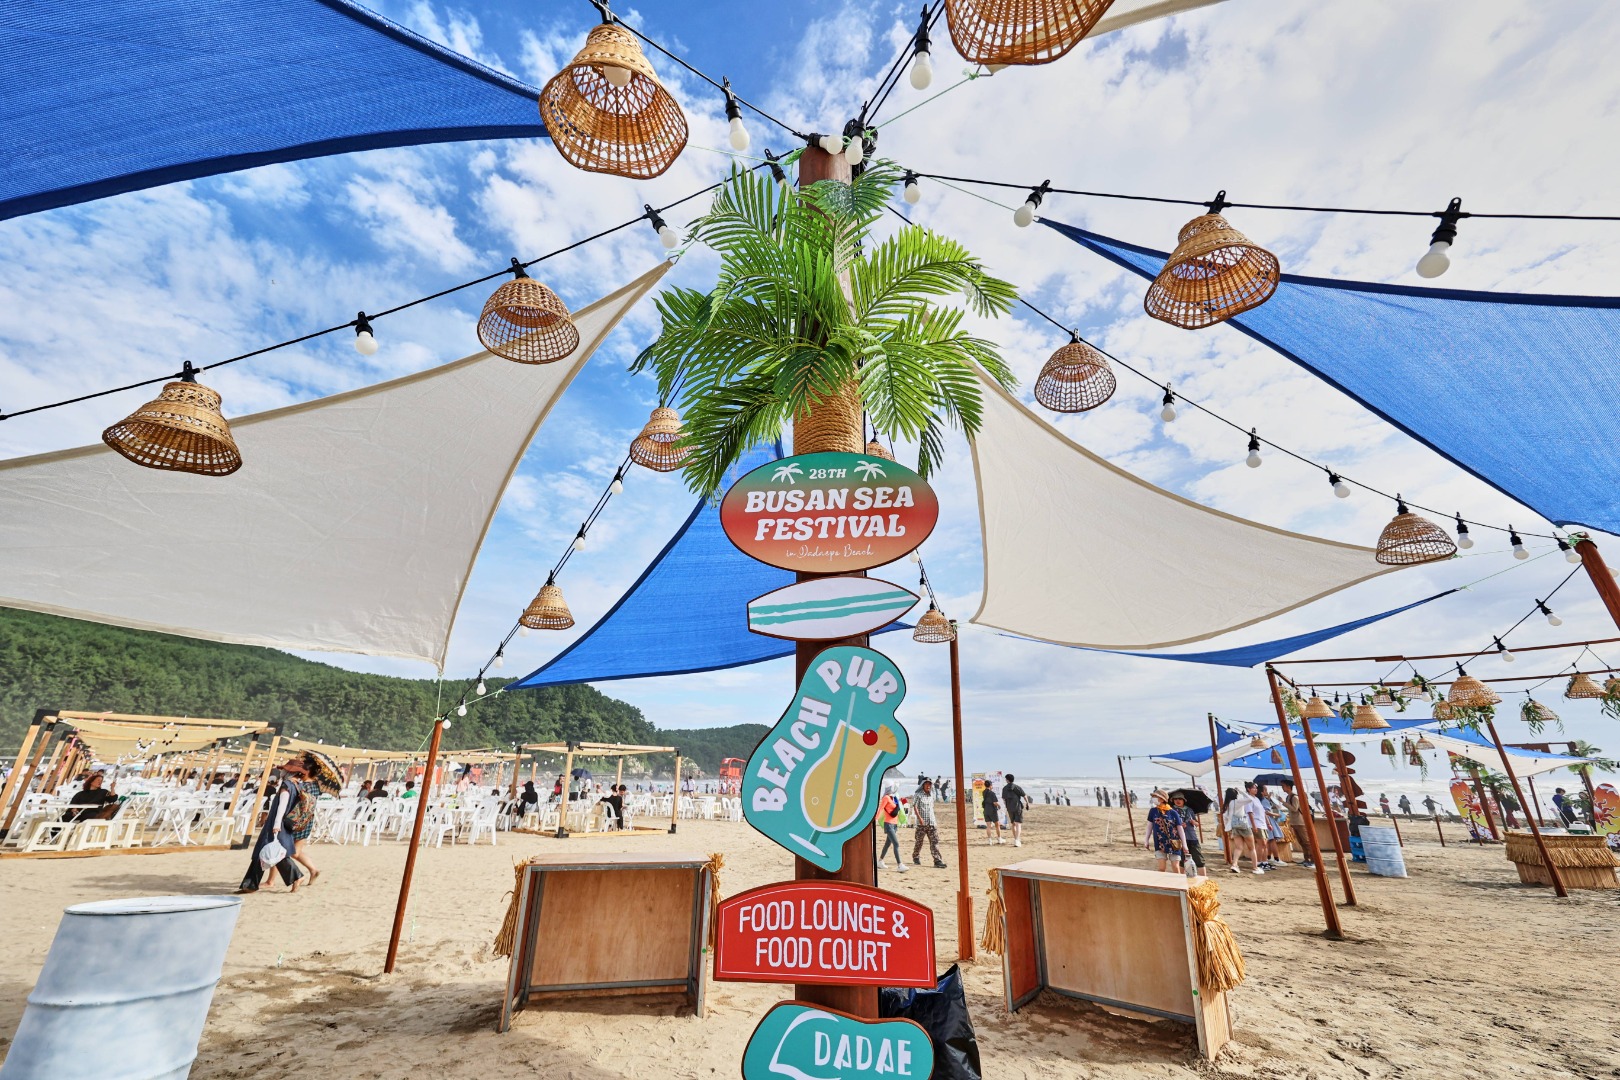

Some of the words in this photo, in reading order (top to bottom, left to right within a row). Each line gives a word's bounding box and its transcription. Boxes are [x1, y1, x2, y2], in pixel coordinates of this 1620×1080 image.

[809, 468, 847, 480] 28TH
[744, 488, 849, 513] BUSAN
[852, 486, 915, 511] SEA
[754, 514, 906, 541] FESTIVAL
[786, 549, 796, 557] in
[843, 543, 874, 558] Beach
[752, 696, 832, 812] BEACH
[816, 655, 898, 704] PUB
[739, 901, 795, 933] FOOD
[800, 899, 886, 935] LOUNGE
[892, 910, 910, 939] &
[755, 937, 812, 968] FOOD
[818, 938, 891, 971] COURT
[814, 1031, 912, 1076] DADAE
